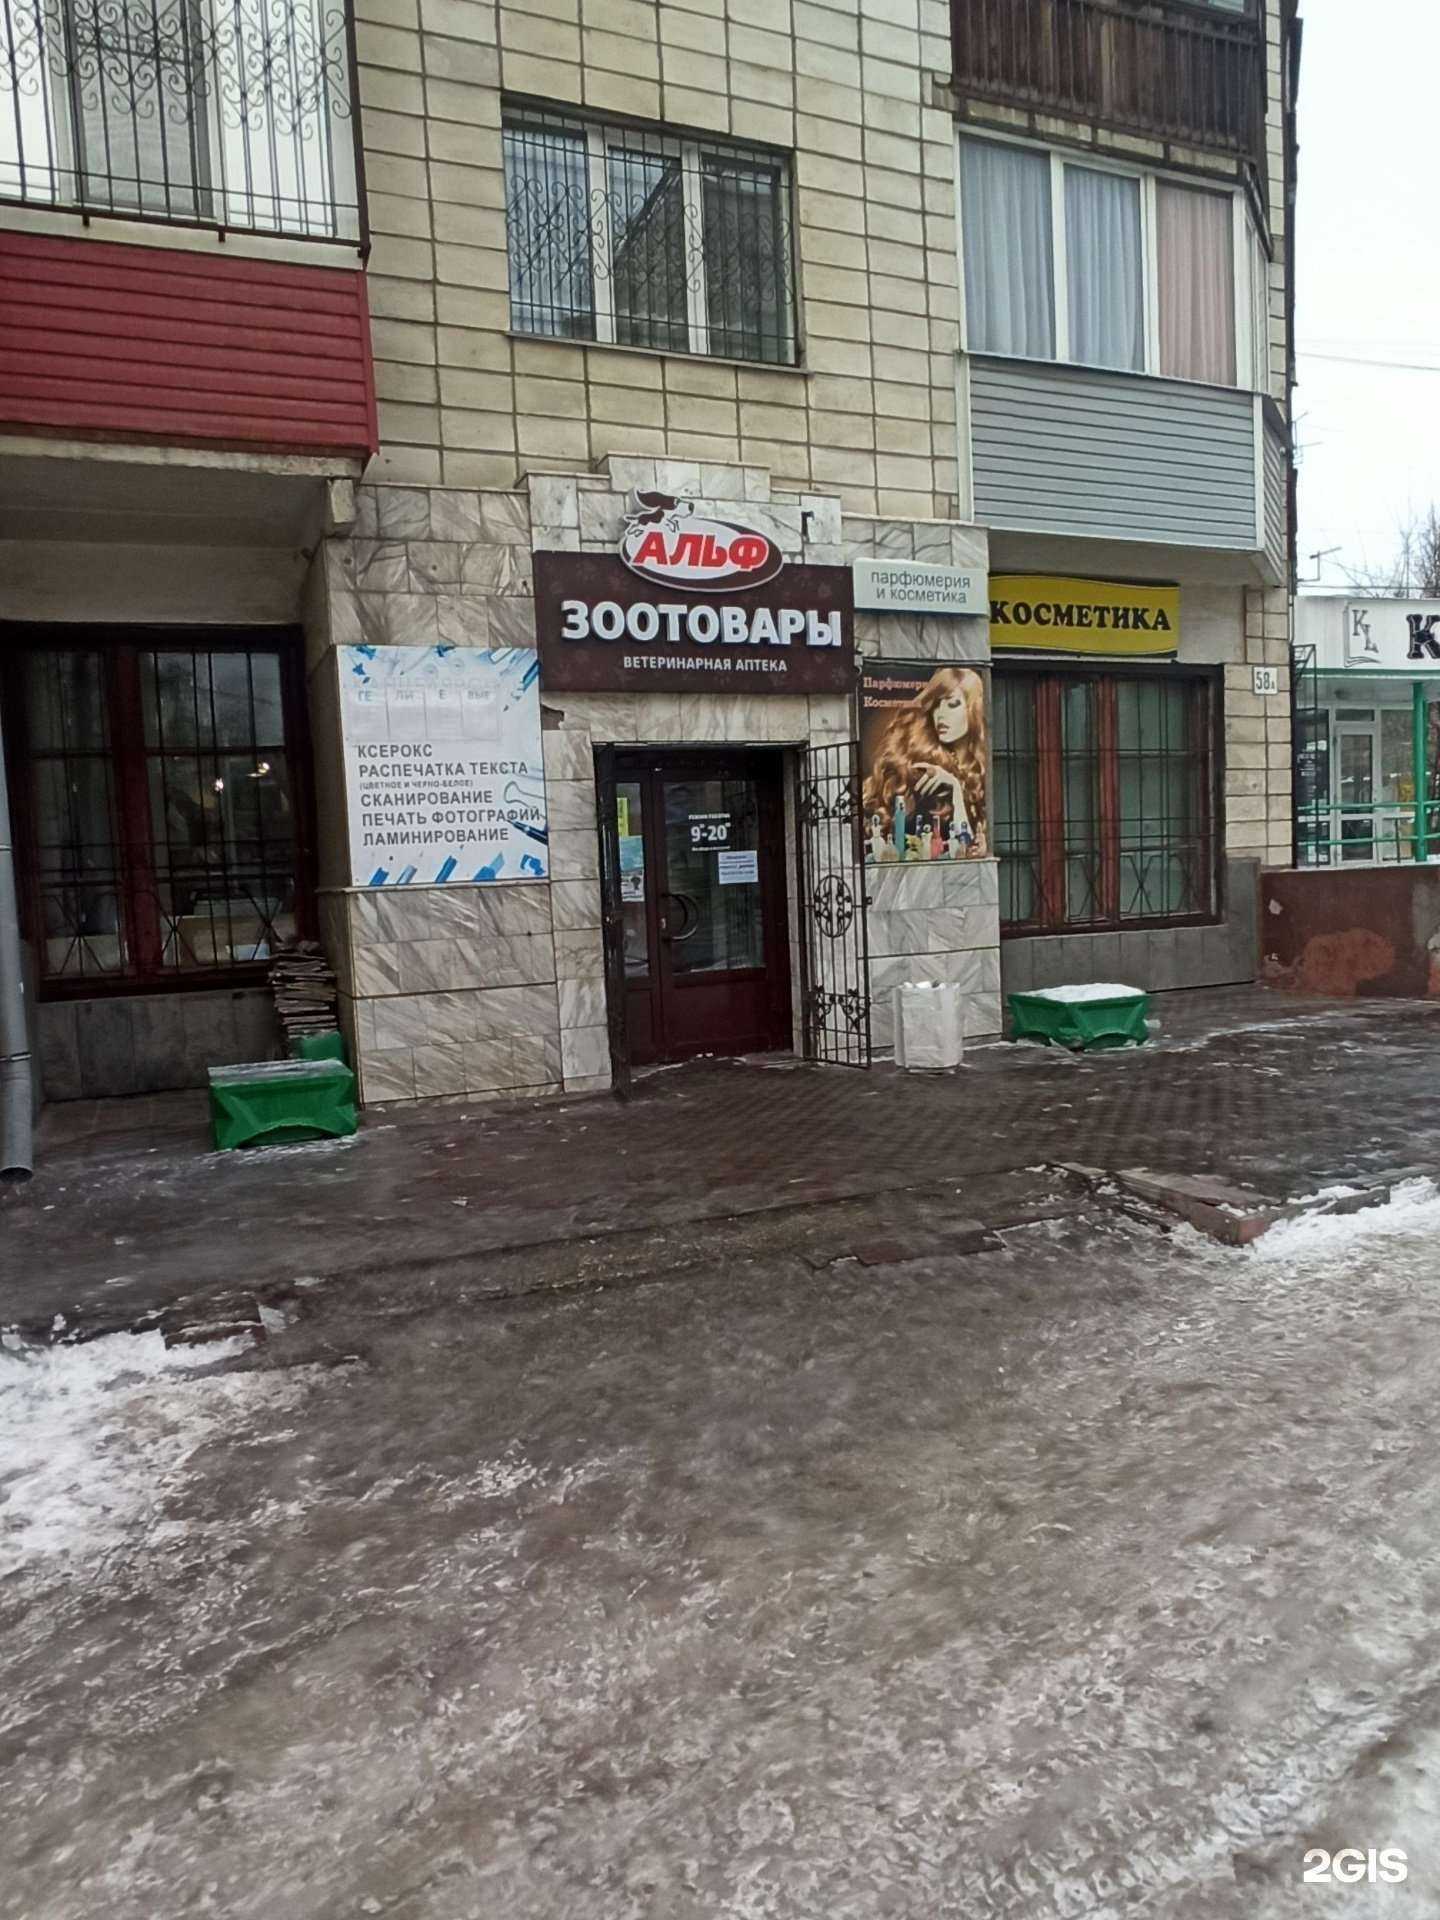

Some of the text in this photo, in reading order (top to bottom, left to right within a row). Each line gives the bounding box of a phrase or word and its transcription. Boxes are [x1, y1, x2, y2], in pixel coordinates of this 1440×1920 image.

[632, 531, 769, 570] АЛЬФ
[871, 571, 971, 589] парфюмерия
[876, 588, 967, 603] и косметика
[561, 599, 842, 647] ЗООТОВАРЫ
[990, 600, 1172, 631] КОСМЕТИКА
[623, 655, 788, 673] ВЕТЕРИНАРНАЯ АПТЕКА
[357, 743, 433, 759] КСЕРОКС
[359, 761, 529, 778] РАСПЕЧАТКА ТЕКСТА
[360, 790, 493, 807] СКАНИРОВАНИЕ
[362, 806, 540, 827] ПЕЧАТЬ ФОТОГРАФИЙ
[362, 827, 509, 847] ЛАМИНИРОВАНИЕ
